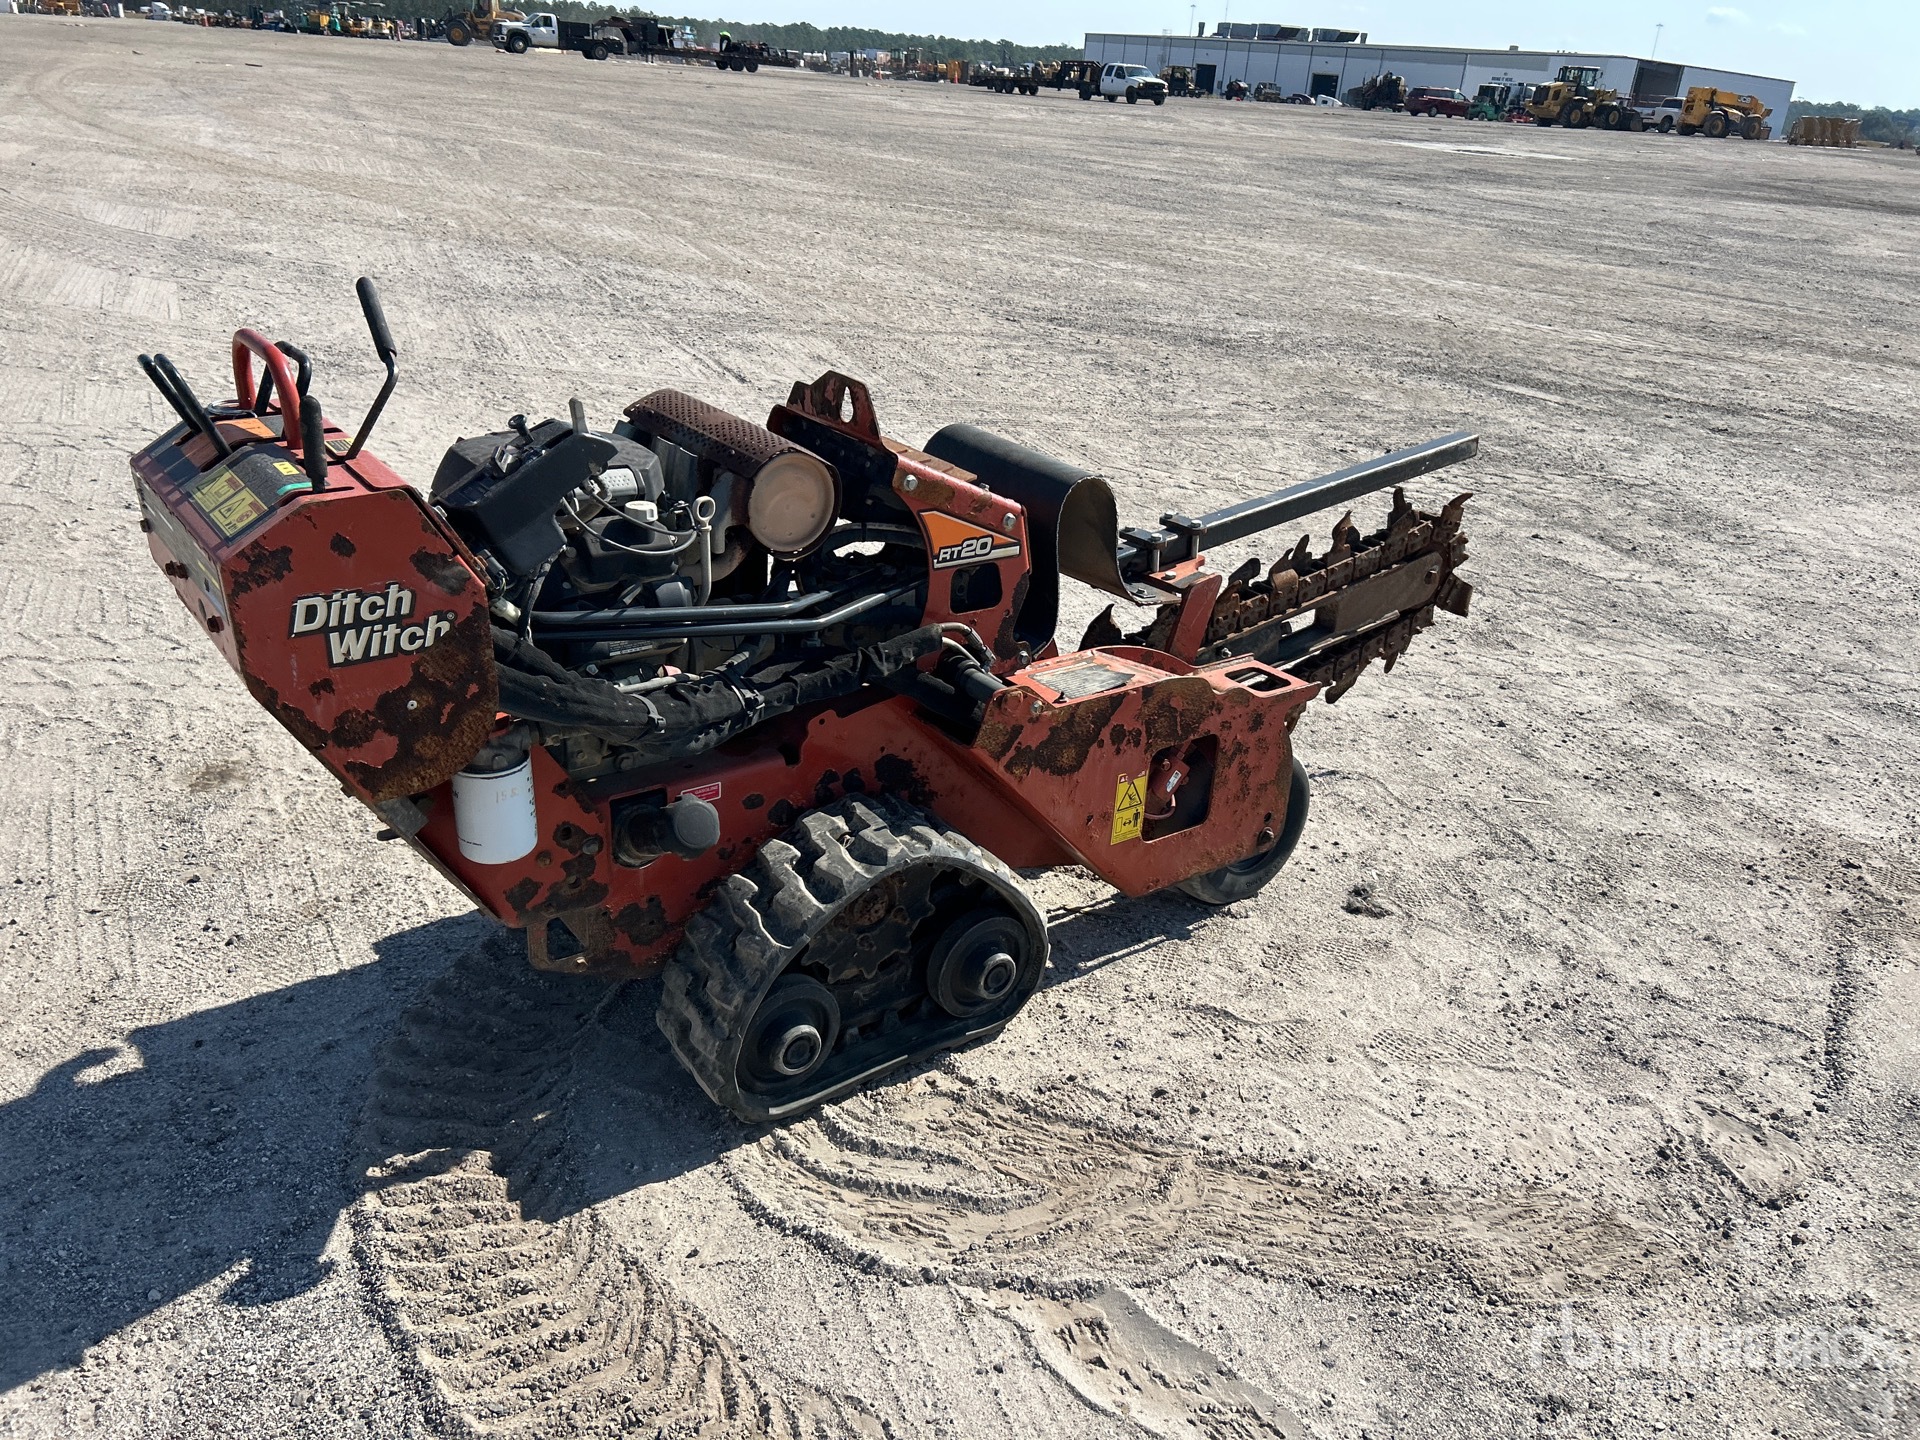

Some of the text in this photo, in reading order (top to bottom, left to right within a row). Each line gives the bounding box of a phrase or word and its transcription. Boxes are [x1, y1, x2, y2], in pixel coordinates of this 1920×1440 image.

[1737, 96, 1751, 104] JCB
[938, 536, 993, 562] RT20
[293, 584, 413, 634] Ditch
[329, 613, 452, 665] Witch
